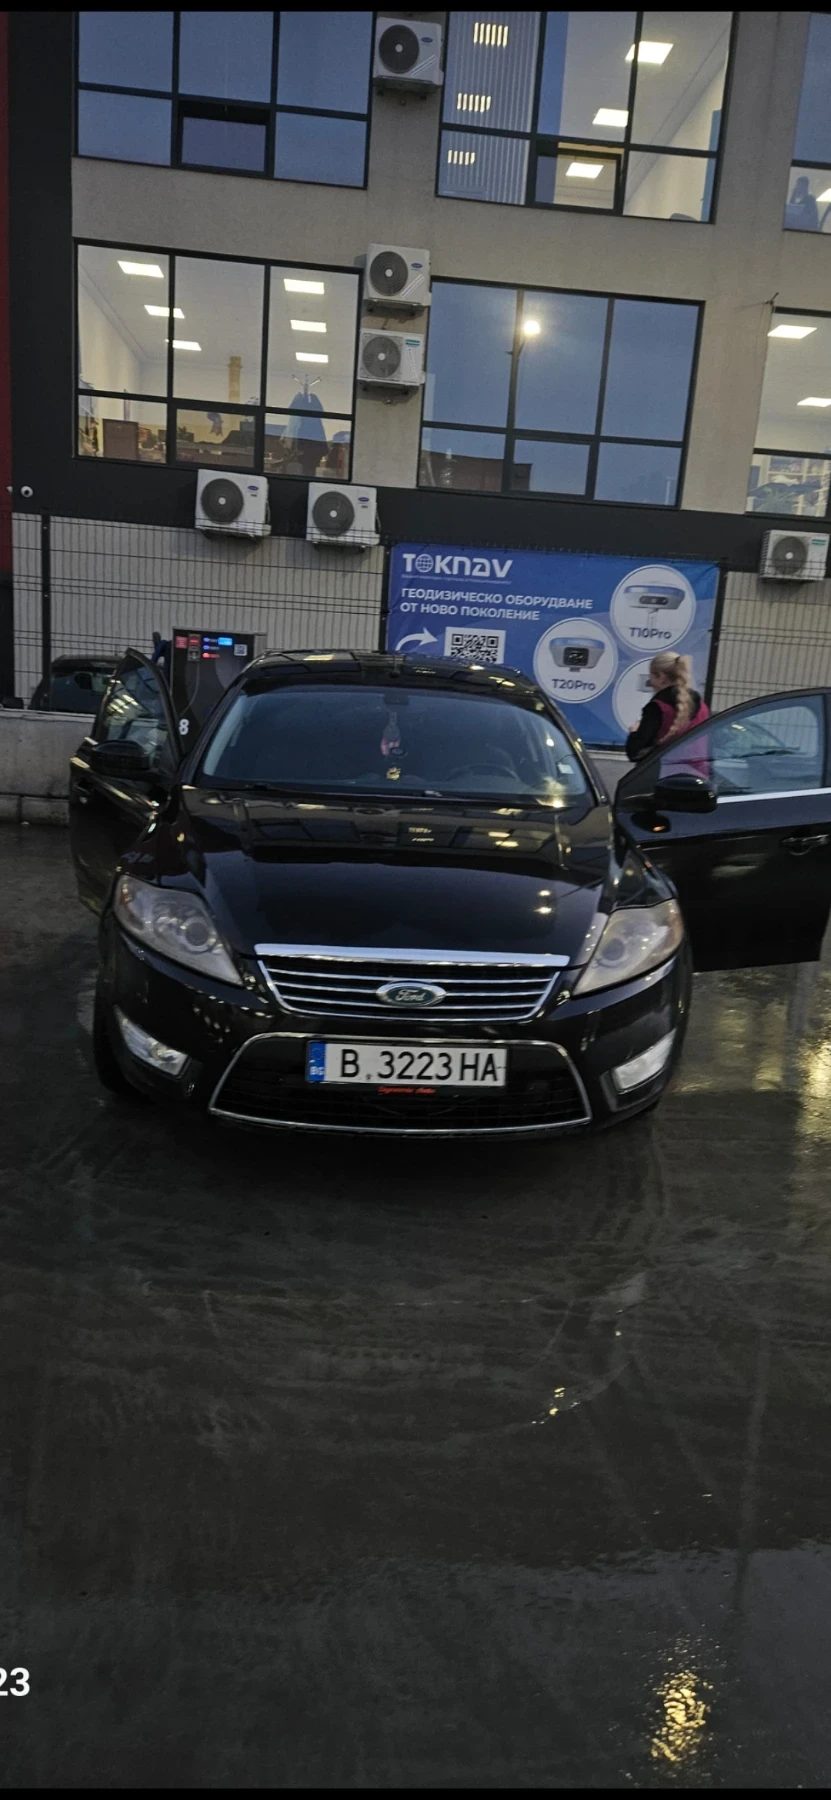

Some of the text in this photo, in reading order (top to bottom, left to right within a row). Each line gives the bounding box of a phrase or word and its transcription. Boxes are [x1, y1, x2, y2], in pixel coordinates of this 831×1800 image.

[401, 587, 594, 611] ГЕОДИЗИЧЕСКО ОБОРУДВАНЕ
[400, 602, 540, 621] ОТ НОВО ПОКОЛЕНИЕ
[629, 626, 672, 640] T10Pro
[551, 678, 597, 692] T20Pro
[178, 718, 190, 736] 8
[395, 989, 427, 1001] Ford
[340, 1048, 498, 1081] B 3223 HA
